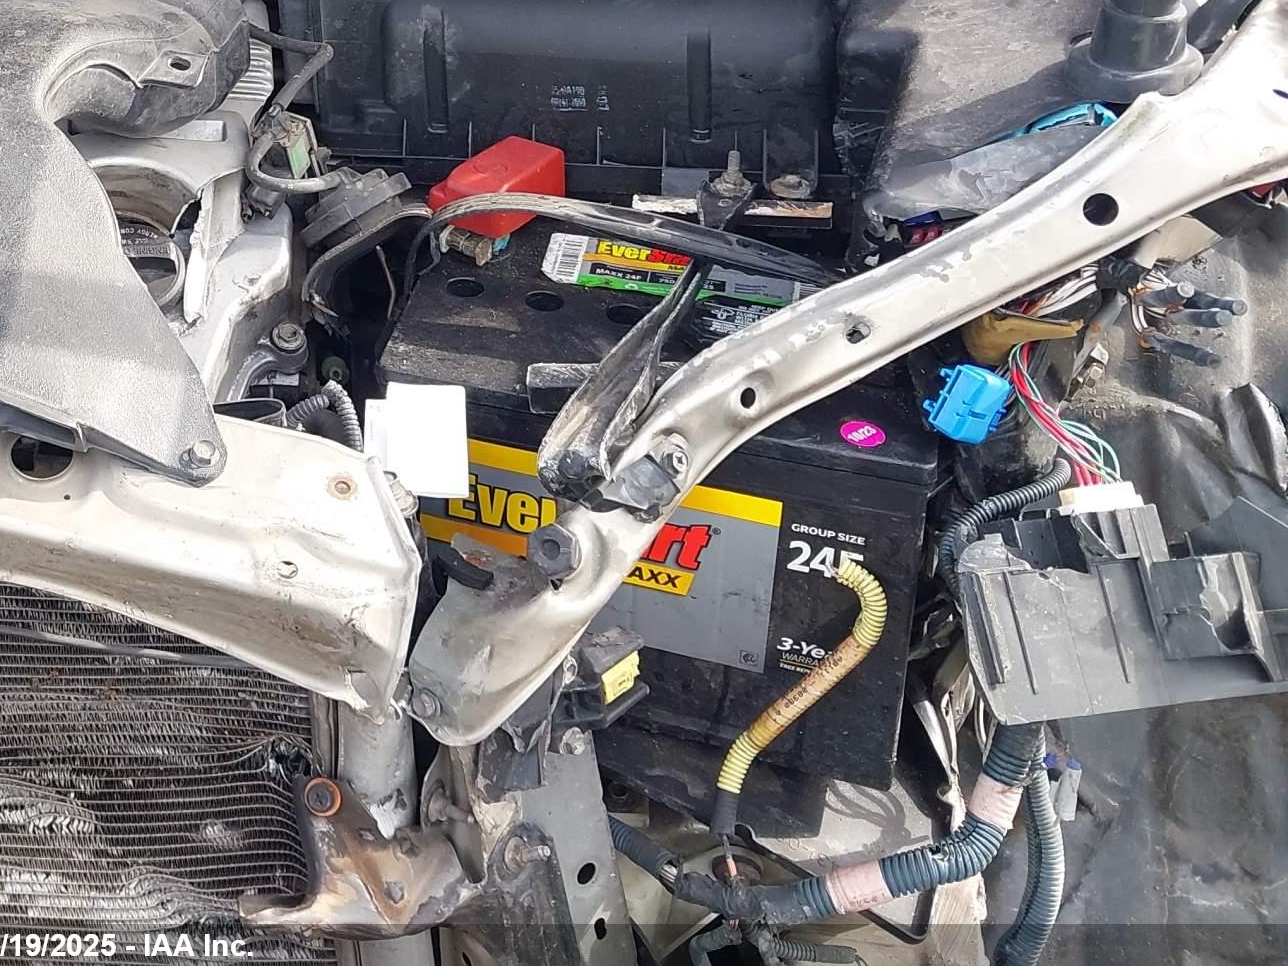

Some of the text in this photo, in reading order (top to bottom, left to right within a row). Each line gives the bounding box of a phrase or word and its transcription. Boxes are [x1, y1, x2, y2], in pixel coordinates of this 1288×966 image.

[791, 522, 866, 546] GROUP SIZE
[626, 566, 680, 590] AXX
[776, 637, 832, 660] 3-Ye
[782, 651, 819, 668] WARRA
